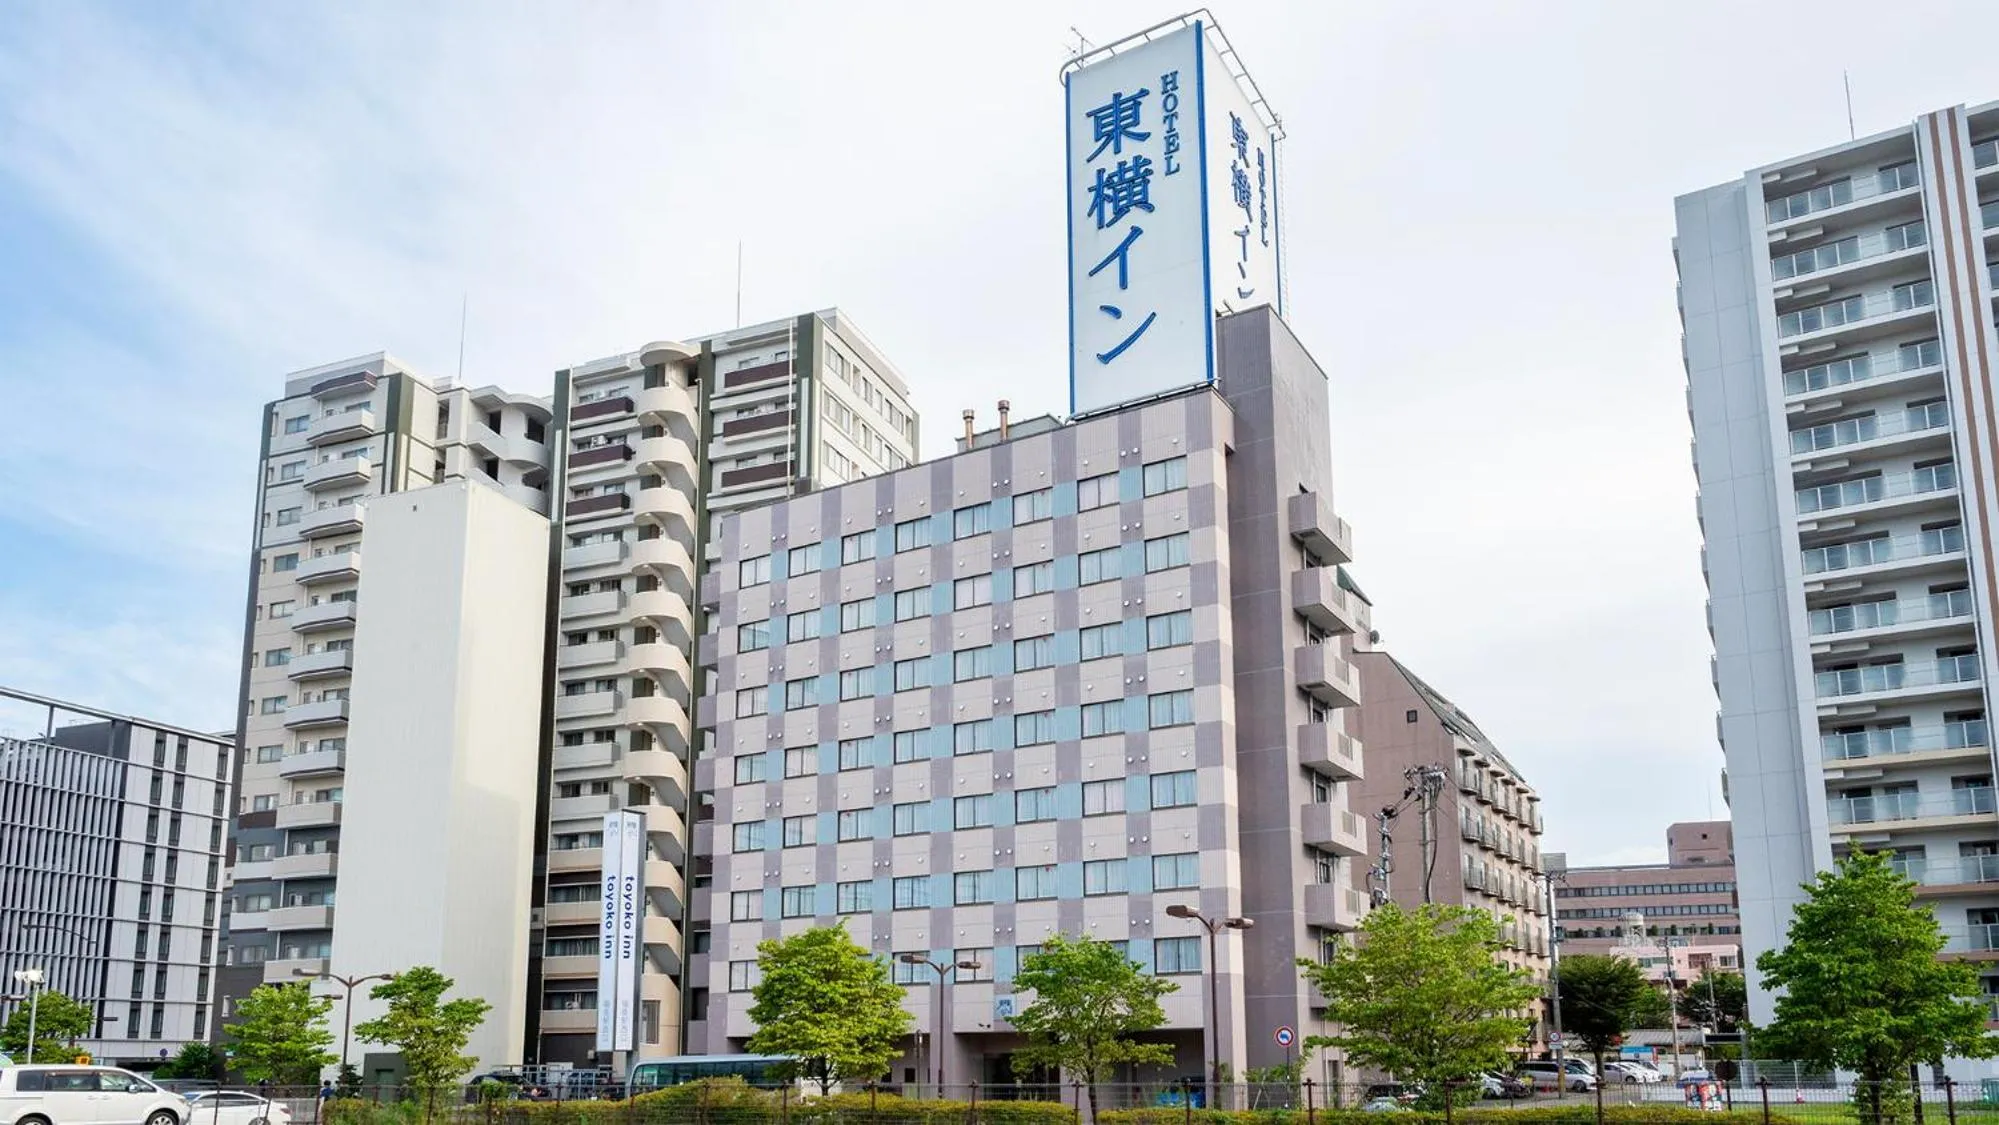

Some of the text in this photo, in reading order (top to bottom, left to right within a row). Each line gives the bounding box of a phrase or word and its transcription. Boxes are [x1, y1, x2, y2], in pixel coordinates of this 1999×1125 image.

[1160, 70, 1181, 177] HOTEL
[1085, 87, 1157, 365] 東横イン
[1229, 111, 1255, 299] 東横イン
[605, 875, 616, 959] toyoko inn
[623, 875, 635, 959] toyoko inn
